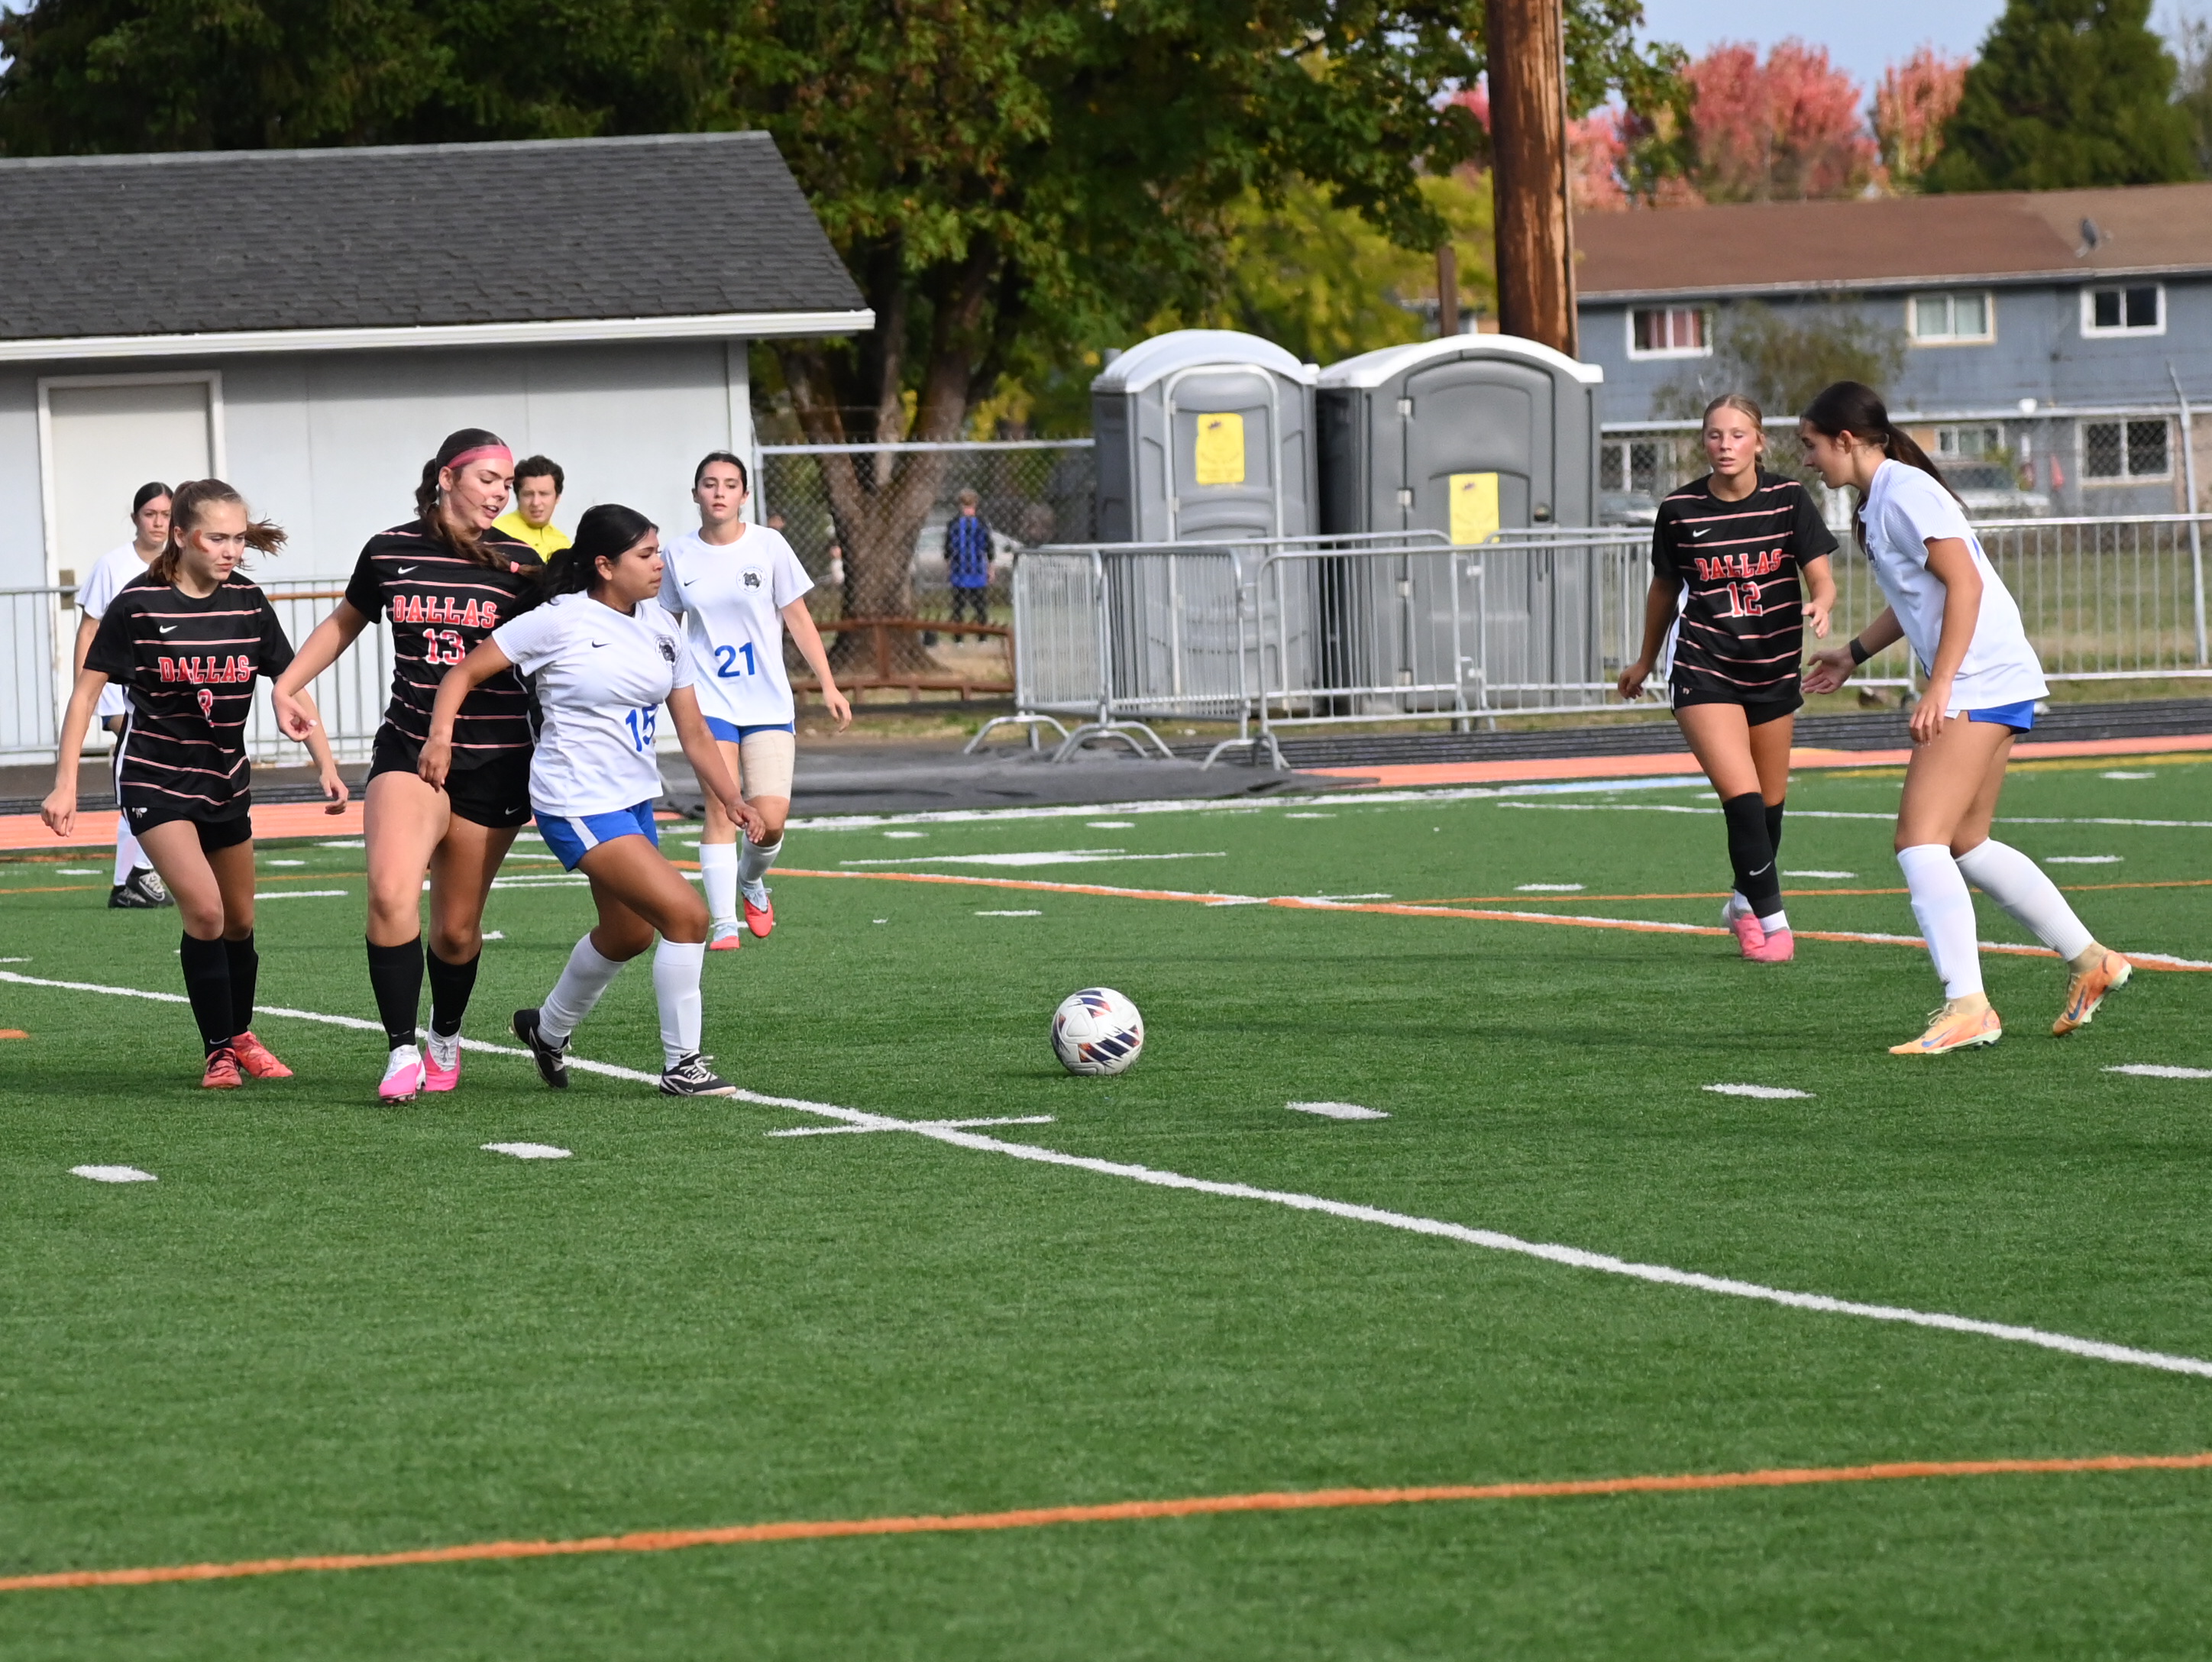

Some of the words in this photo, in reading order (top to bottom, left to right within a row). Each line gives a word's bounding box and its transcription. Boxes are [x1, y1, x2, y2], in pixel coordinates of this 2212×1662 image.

[1694, 548, 1782, 581] DALLAS
[393, 595, 497, 628] DALLAS
[1727, 581, 1763, 617] 12
[422, 628, 466, 665] 13
[714, 642, 755, 678] 21
[158, 655, 251, 684] DALLAS
[626, 703, 658, 752] 15
